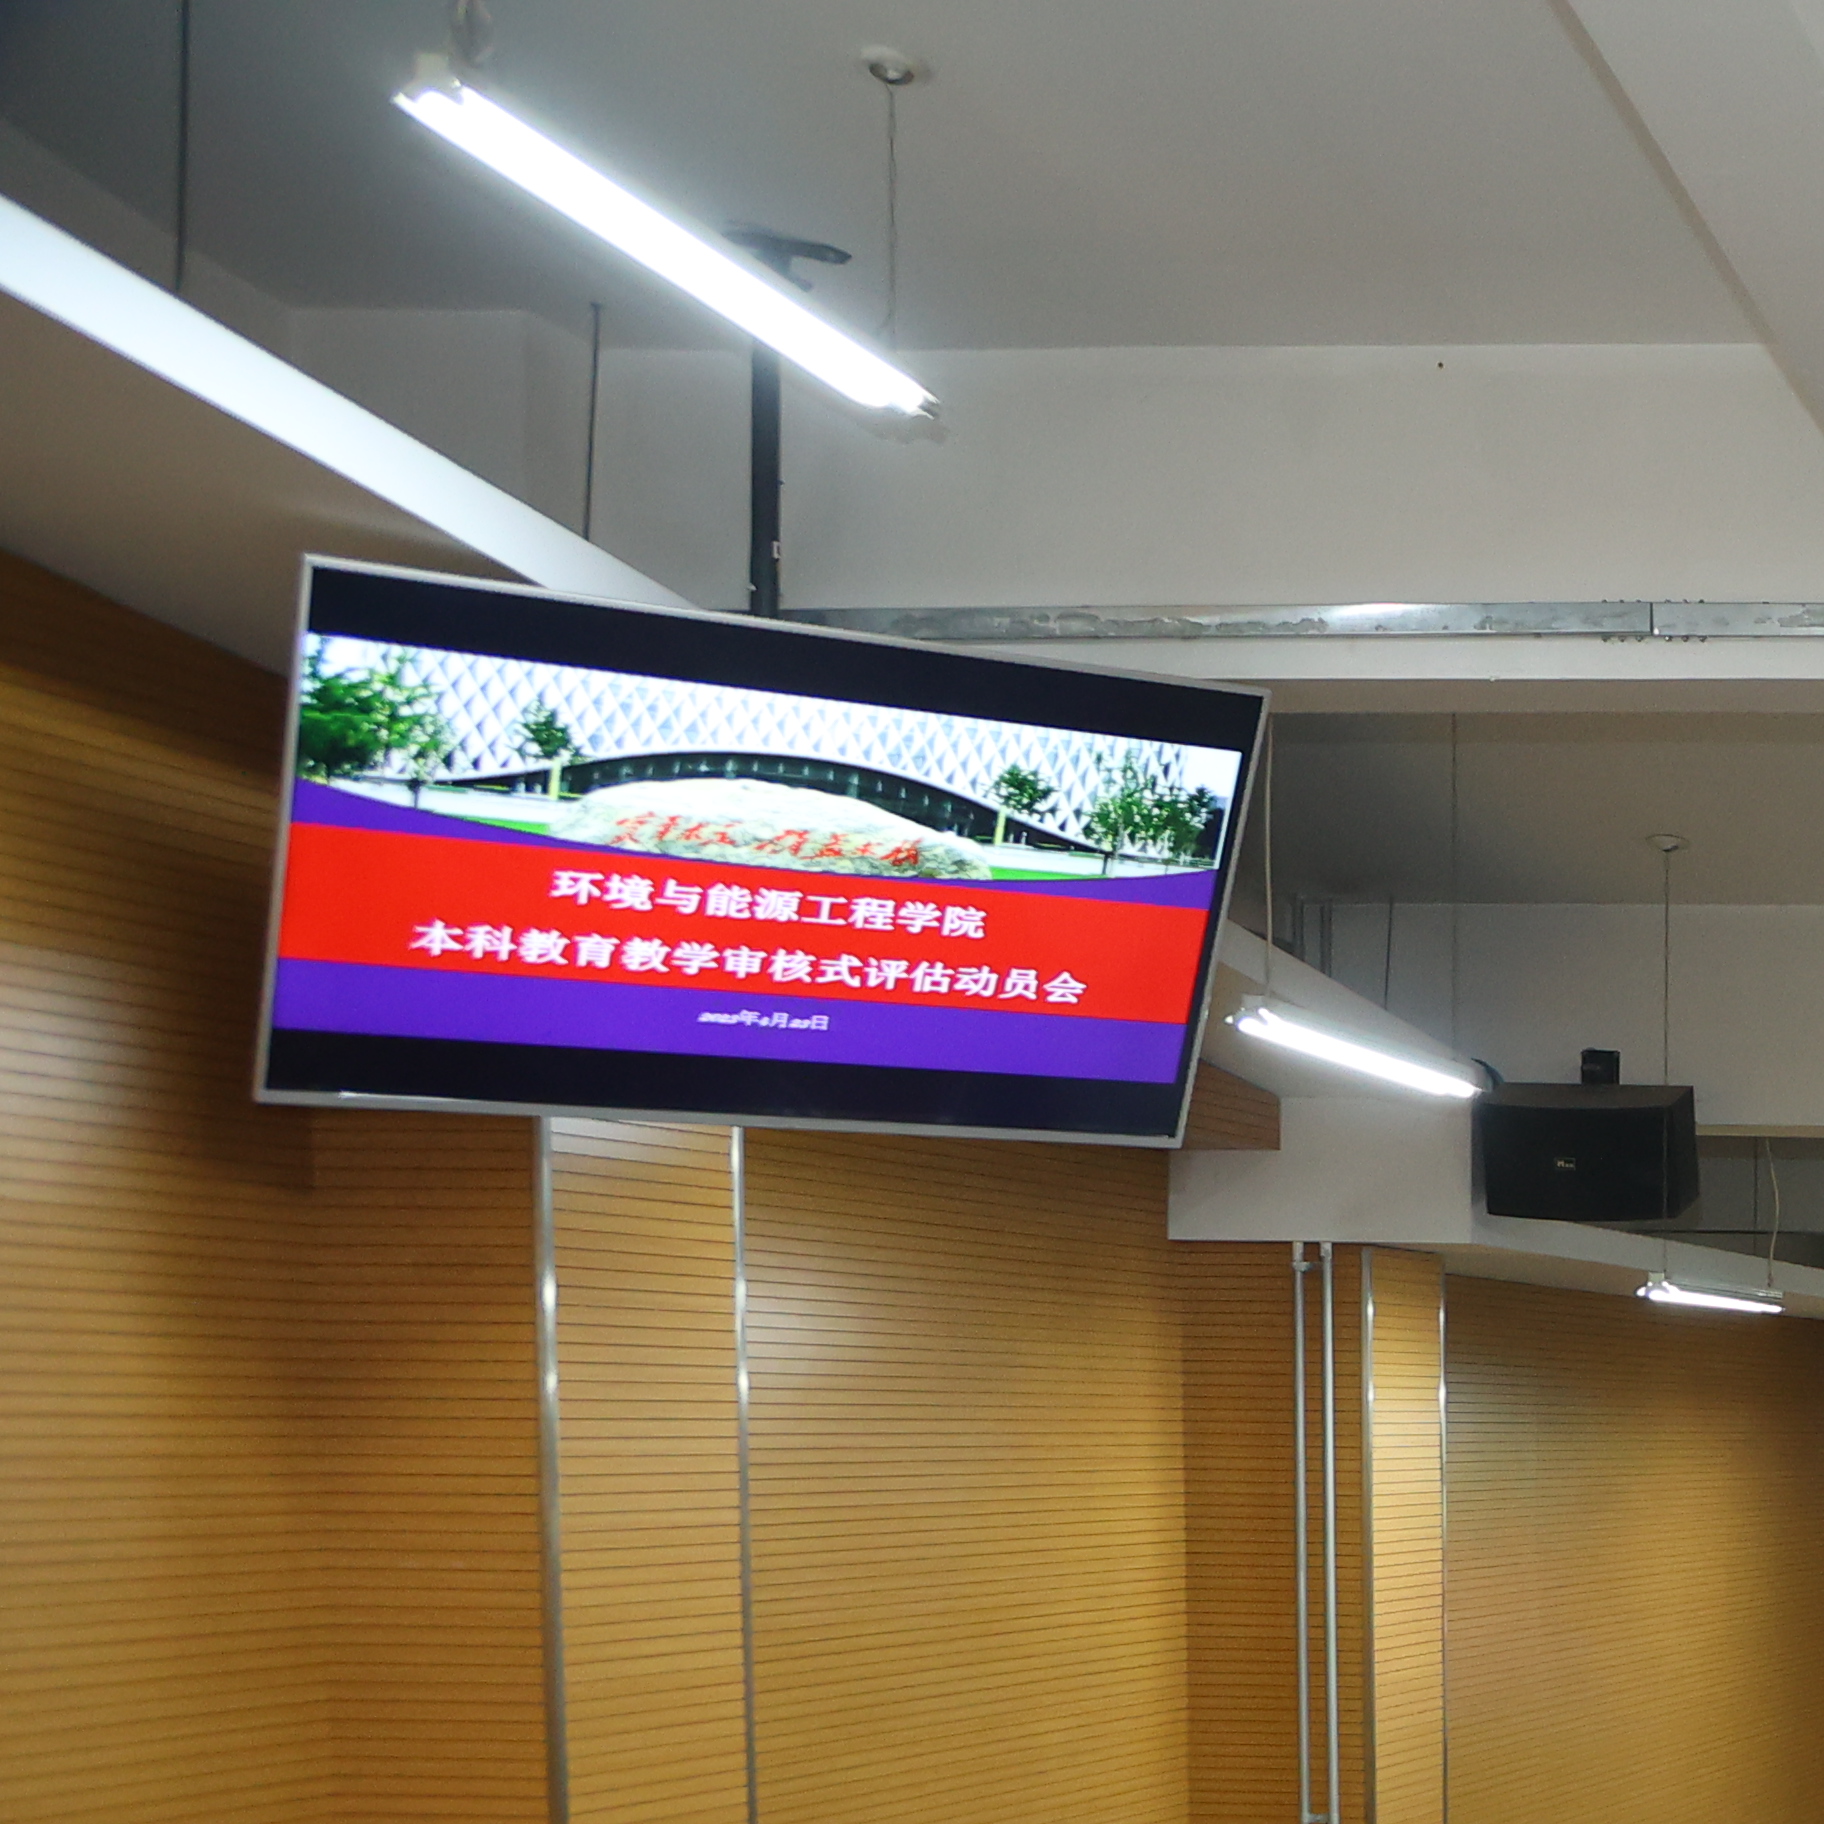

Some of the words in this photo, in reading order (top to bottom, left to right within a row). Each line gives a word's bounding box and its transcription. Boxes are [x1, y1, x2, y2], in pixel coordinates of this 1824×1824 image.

[549, 868, 987, 939] 环境与能源工程学院
[409, 918, 1088, 1006] 本科教育教学审核式评估动员会
